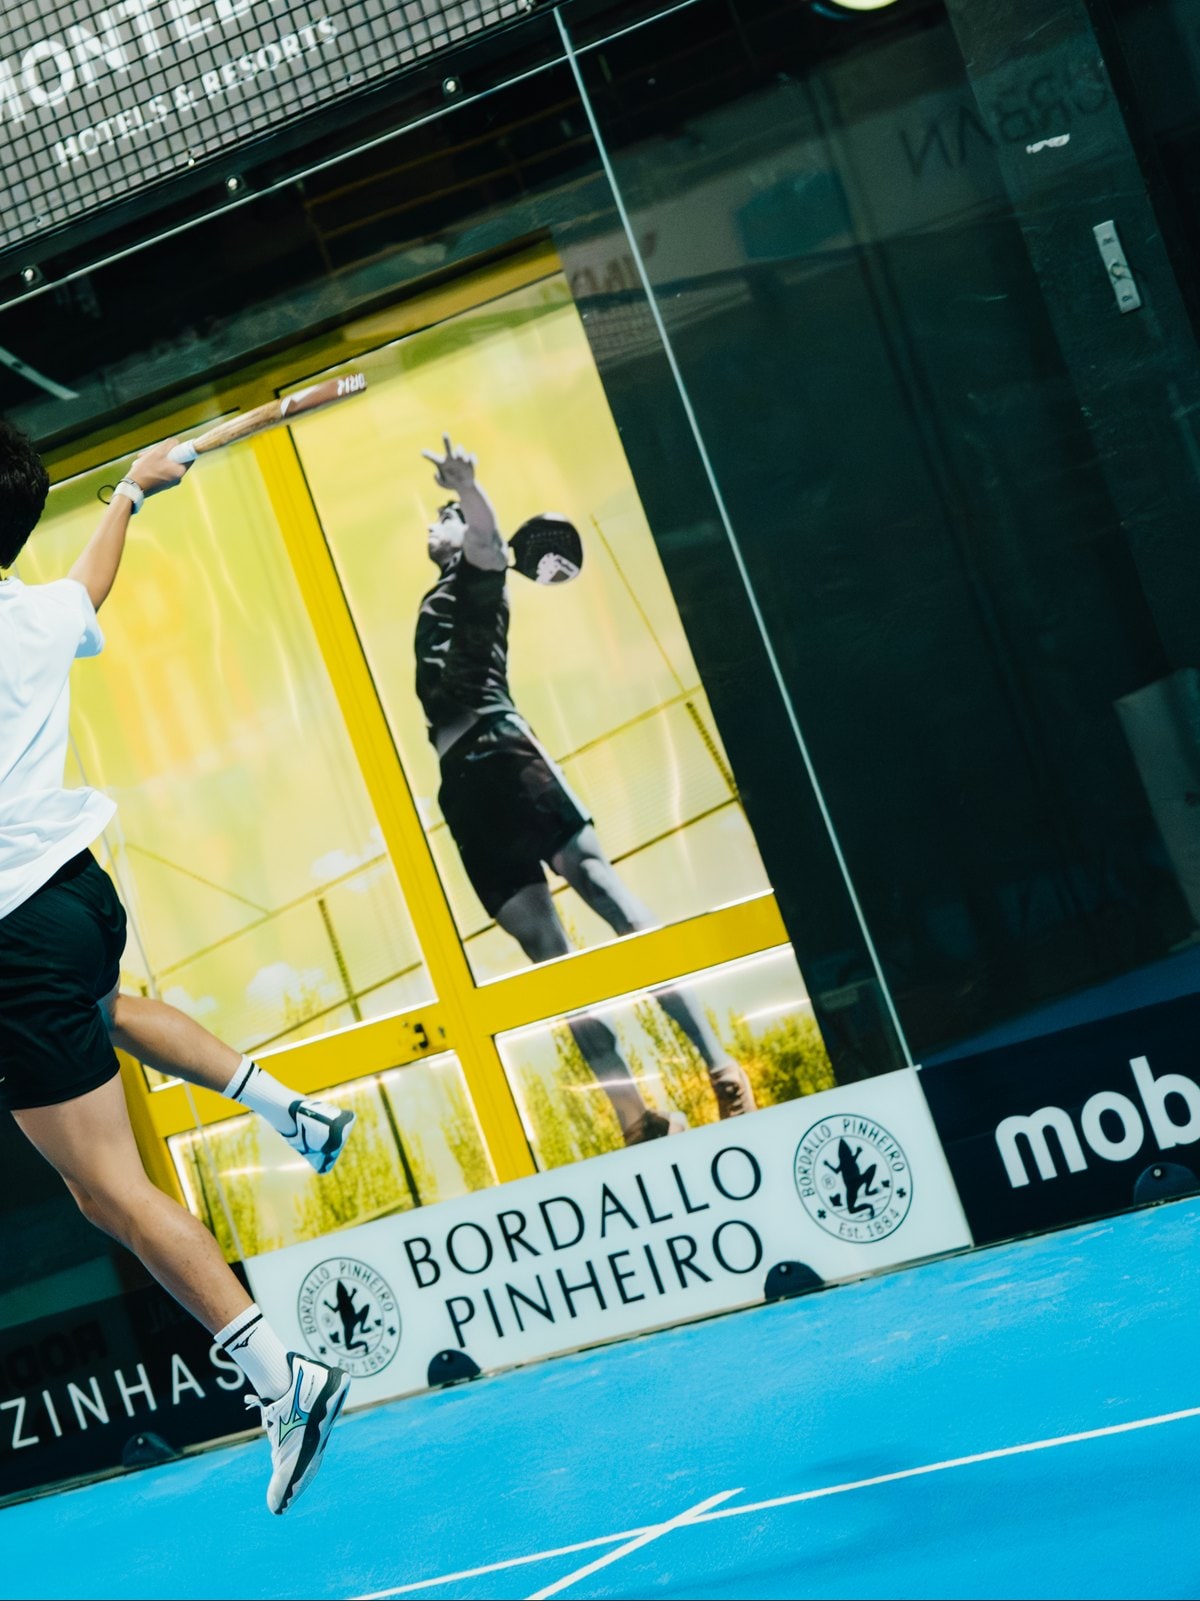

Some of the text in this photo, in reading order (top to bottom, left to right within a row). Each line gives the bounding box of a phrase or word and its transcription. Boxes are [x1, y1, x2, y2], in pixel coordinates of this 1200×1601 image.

[53, 16, 338, 168] HOTELS & RESORTS
[799, 1119, 905, 1198] BORDALLO PINHEIRO
[995, 1055, 1200, 1188] mob
[403, 1146, 762, 1288] BORDALLO
[839, 1208, 899, 1239] Est. 1884
[301, 1261, 394, 1335] BORDALLO PINHEIRO
[445, 1220, 763, 1348] PINHEIRO
